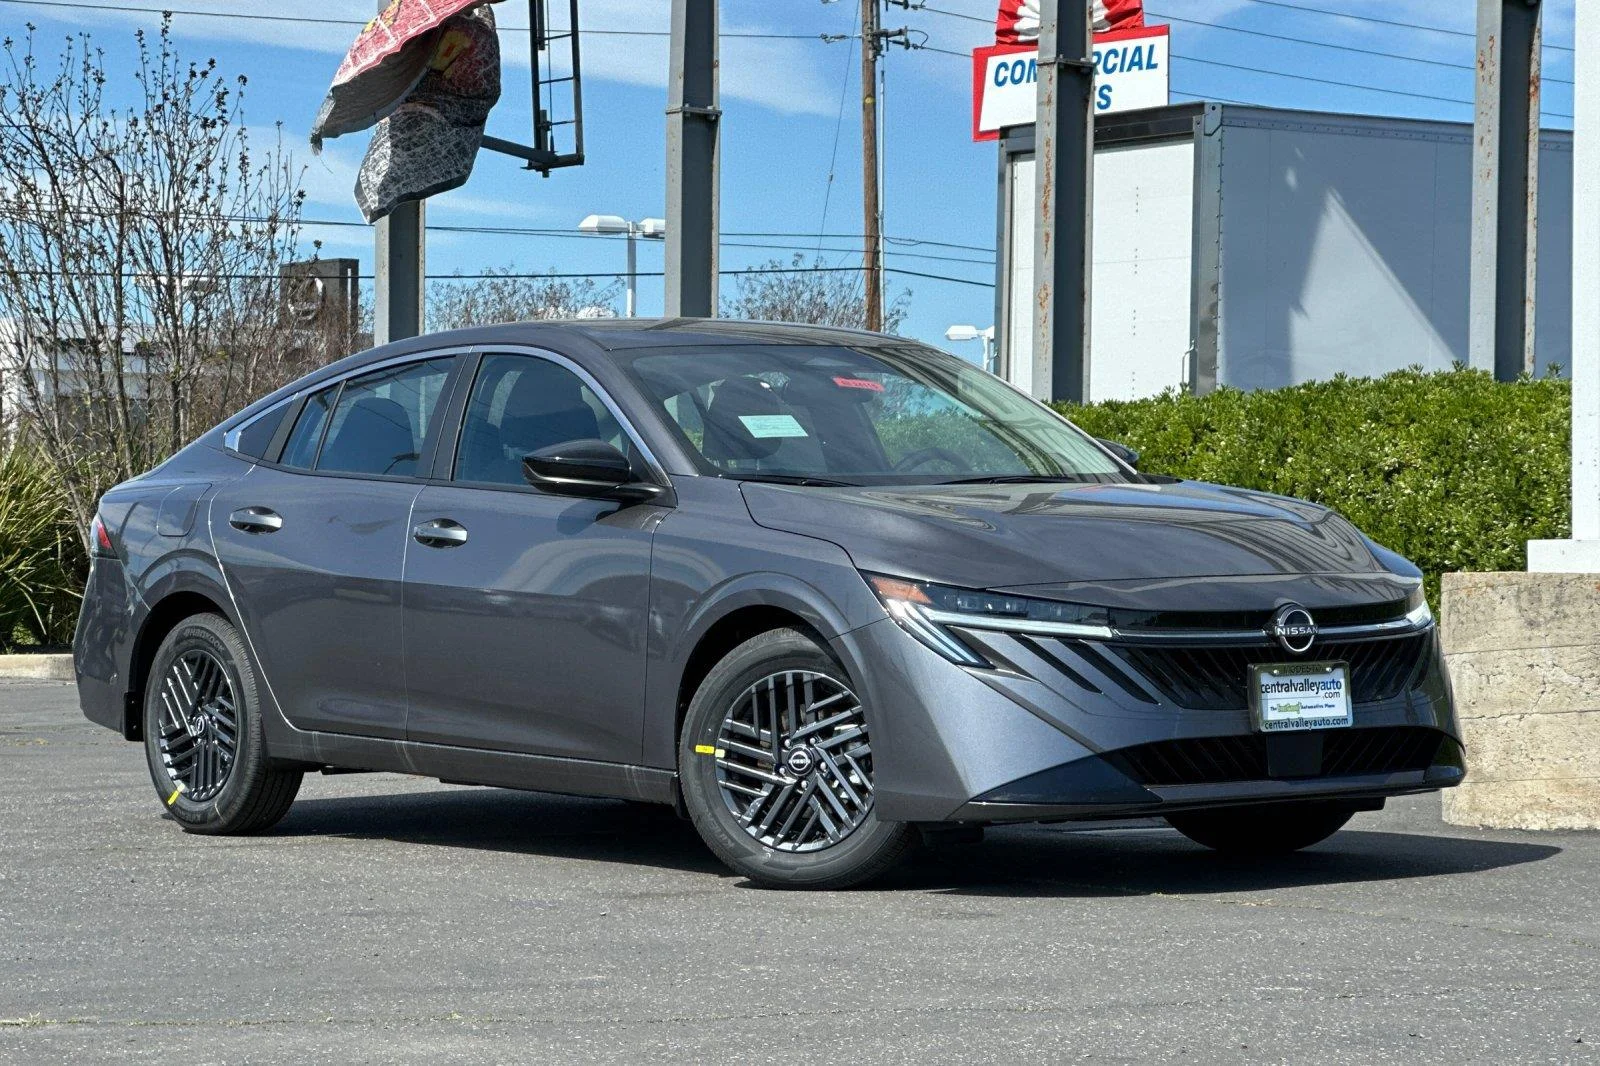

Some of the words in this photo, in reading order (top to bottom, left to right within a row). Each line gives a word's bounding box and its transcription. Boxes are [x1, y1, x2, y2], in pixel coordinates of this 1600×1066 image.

[1277, 626, 1318, 635] NISSAN
[1261, 678, 1342, 695] centralvalleyauto
[1323, 691, 1340, 699] .com
[1264, 717, 1348, 729] centralvalleyauto.com
